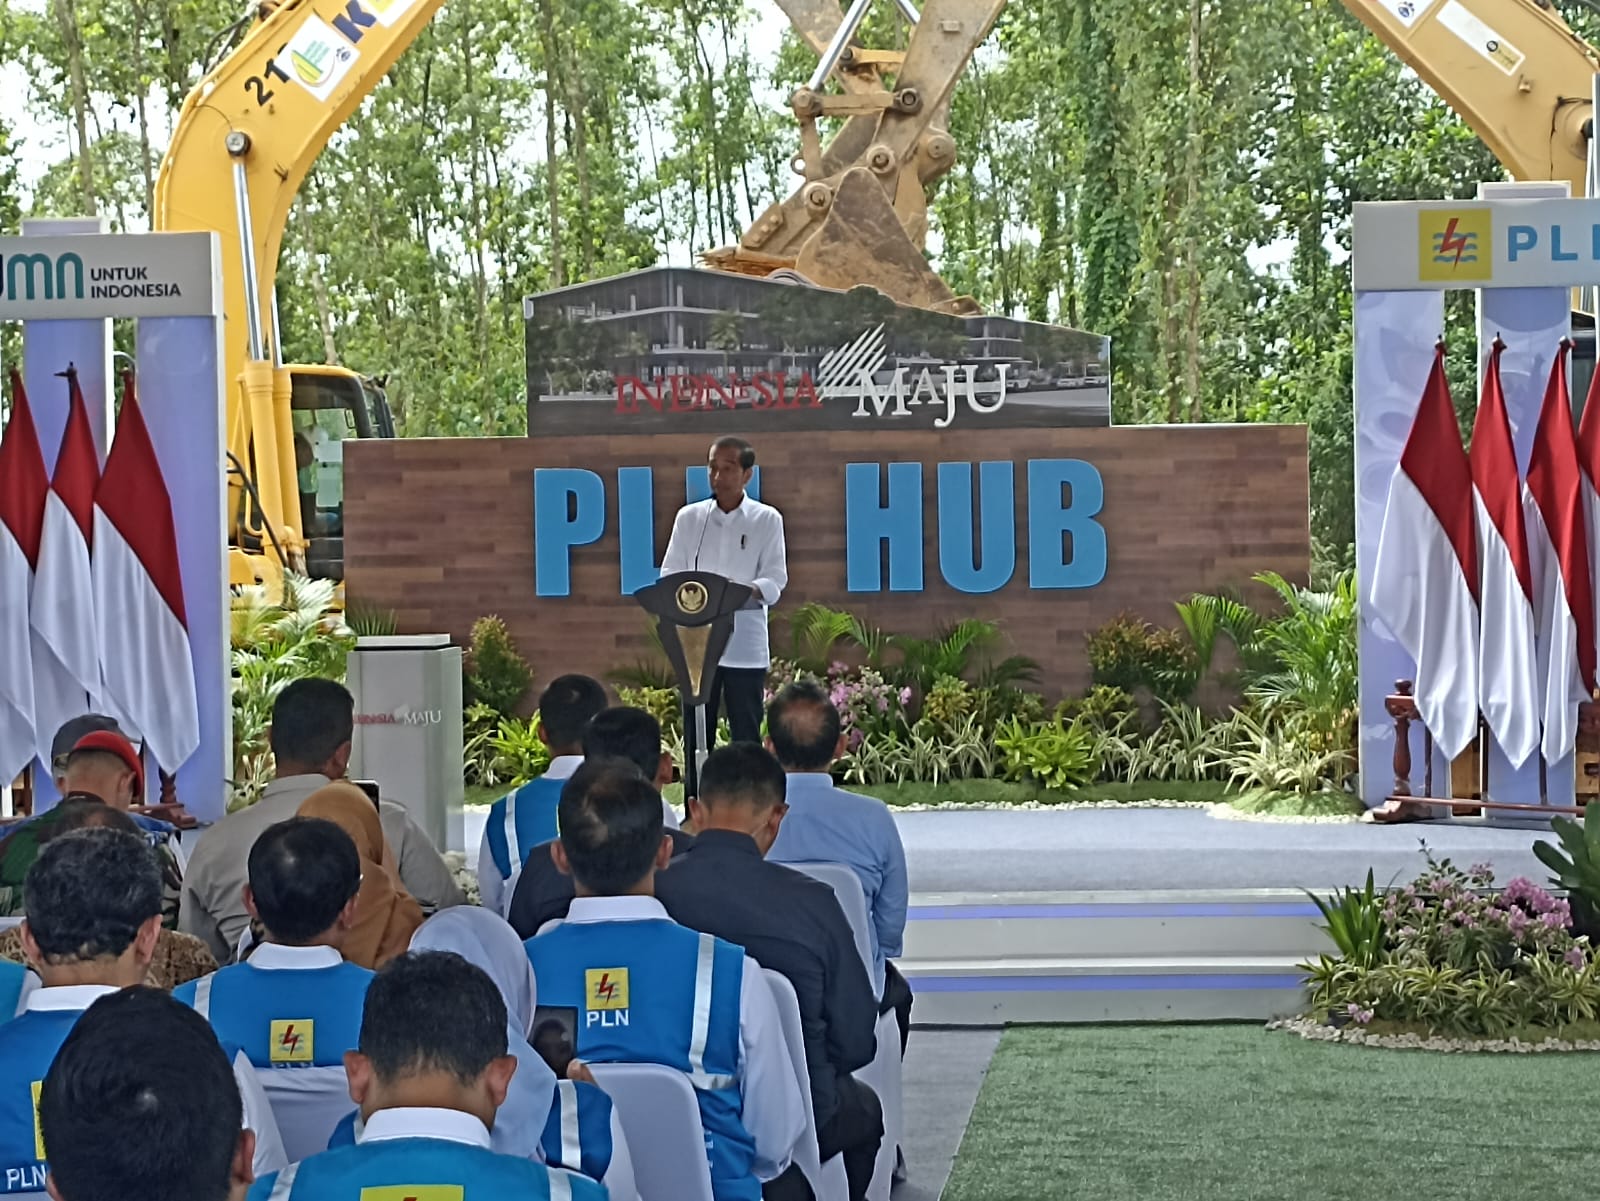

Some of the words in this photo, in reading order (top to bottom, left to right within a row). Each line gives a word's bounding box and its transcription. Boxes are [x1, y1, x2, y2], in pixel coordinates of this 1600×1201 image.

[244, 42, 289, 107] 21
[0, 252, 84, 301] mn
[90, 266, 148, 282] UNTUK
[90, 282, 182, 299] INDONESIA
[852, 363, 1010, 428] MAJU
[534, 466, 761, 597] PL
[846, 458, 1108, 594] HUB
[404, 709, 442, 727] MAJU
[586, 1009, 630, 1028] PLN
[6, 1164, 46, 1190] PLN
